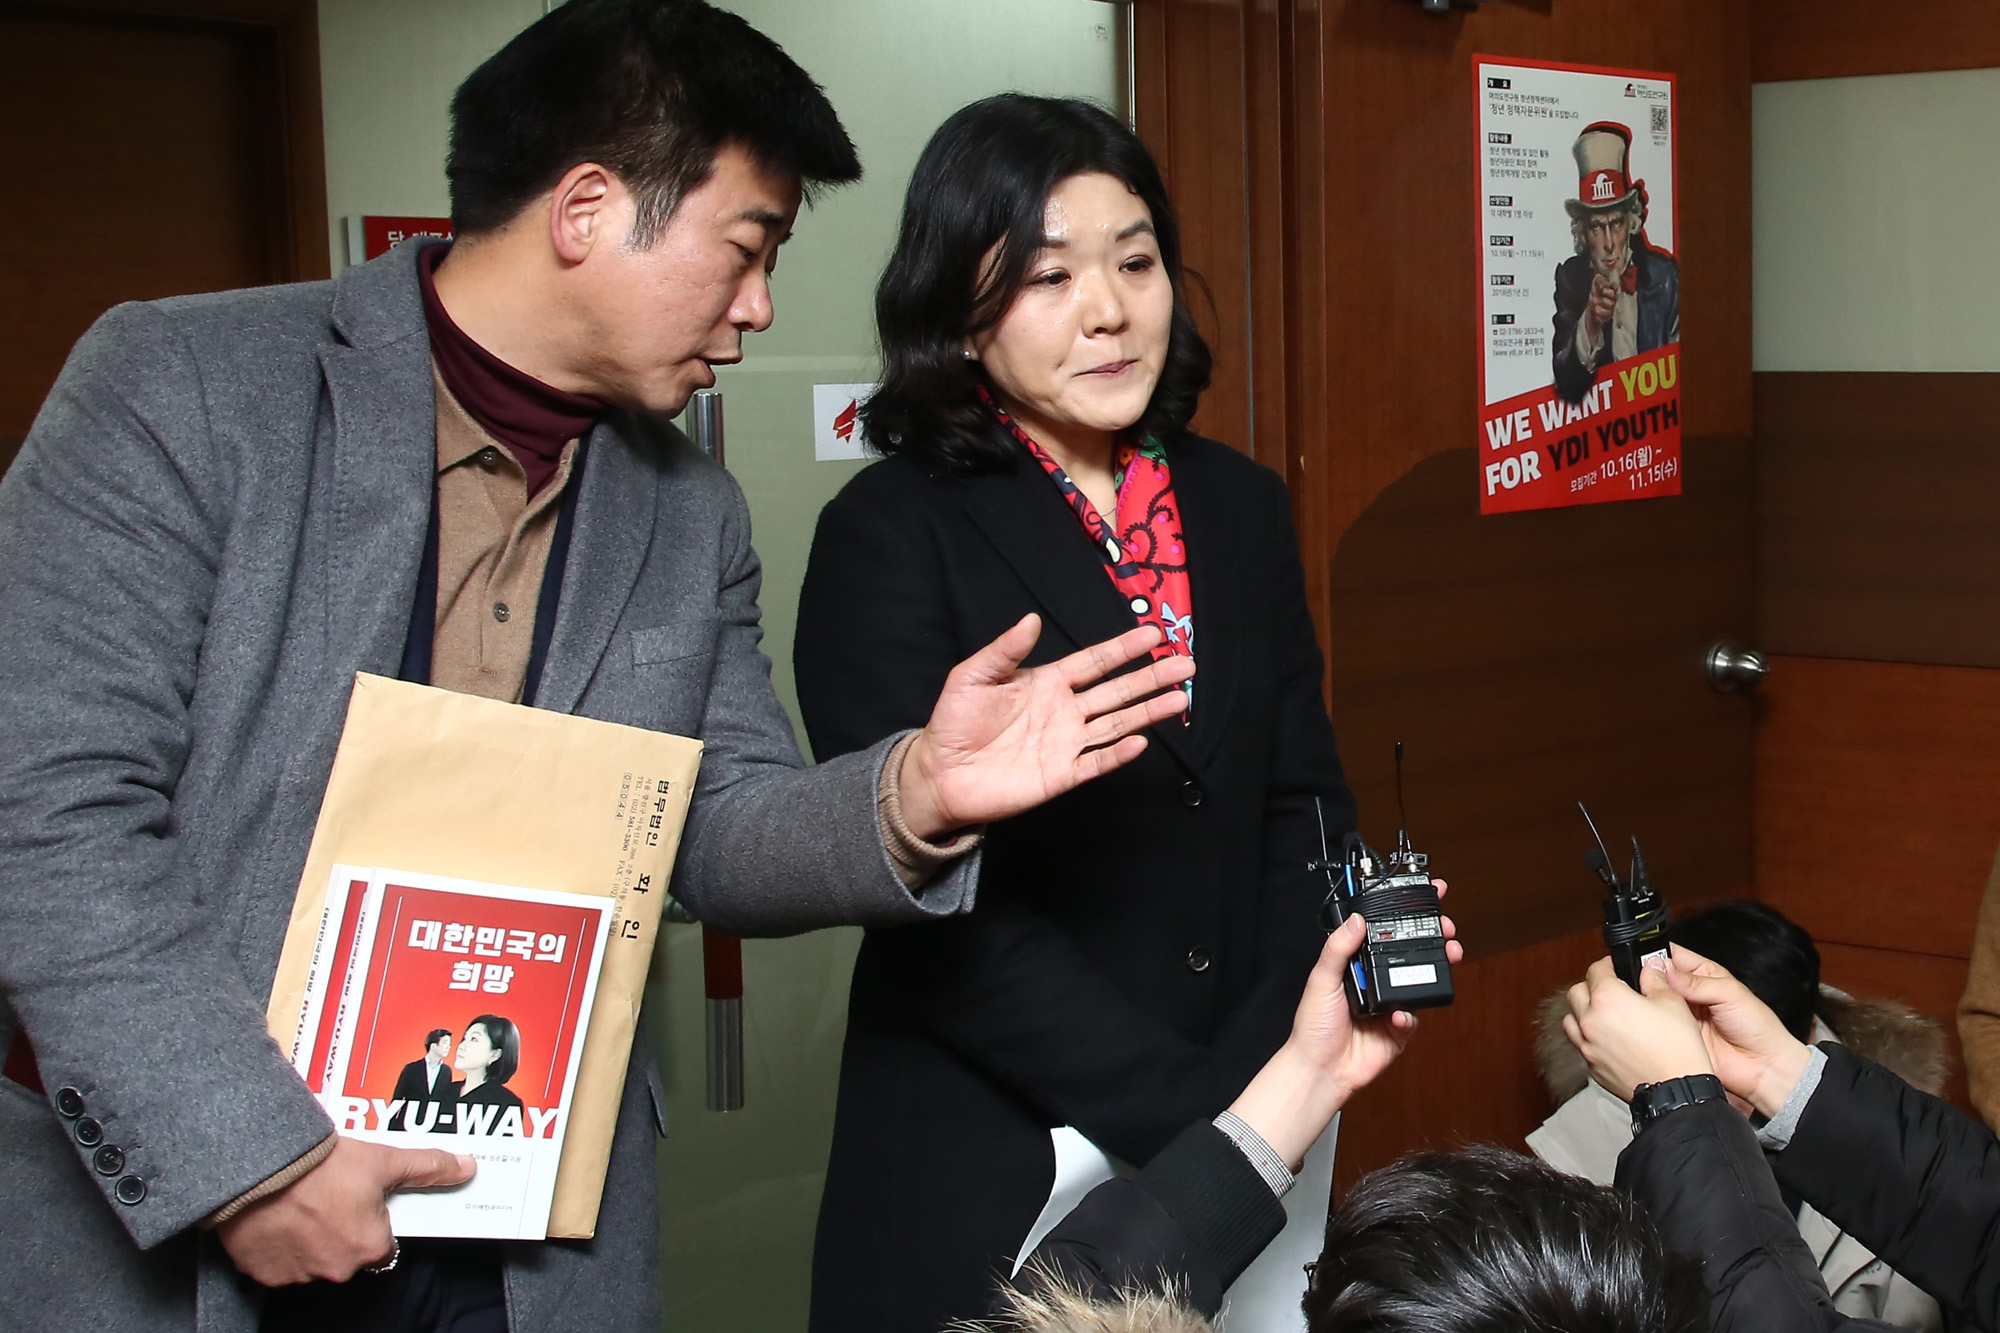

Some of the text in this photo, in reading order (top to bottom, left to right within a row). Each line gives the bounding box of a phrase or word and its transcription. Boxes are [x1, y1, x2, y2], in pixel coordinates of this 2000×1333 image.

[1488, 92, 1519, 102] 여의도연구원
[1485, 354, 1677, 451] WE WANT YOU
[1485, 398, 1679, 496] FOR YDI YOUTH
[1570, 471, 1598, 493] 모집기간
[1600, 445, 1652, 479] 10.16(월)
[1628, 457, 1678, 491] 11.15(수)
[615, 773, 632, 819] 05044
[634, 775, 644, 791] TEL
[620, 815, 636, 851] 581-3300
[645, 780, 669, 846] 법무법인
[615, 858, 625, 876] FAX
[407, 918, 568, 965] 대한민국의
[448, 959, 515, 995] 희망
[289, 999, 309, 1066] RYU-WA
[324, 1003, 346, 1083] RYU-WAY
[339, 1094, 561, 1140] RYU-WAY
